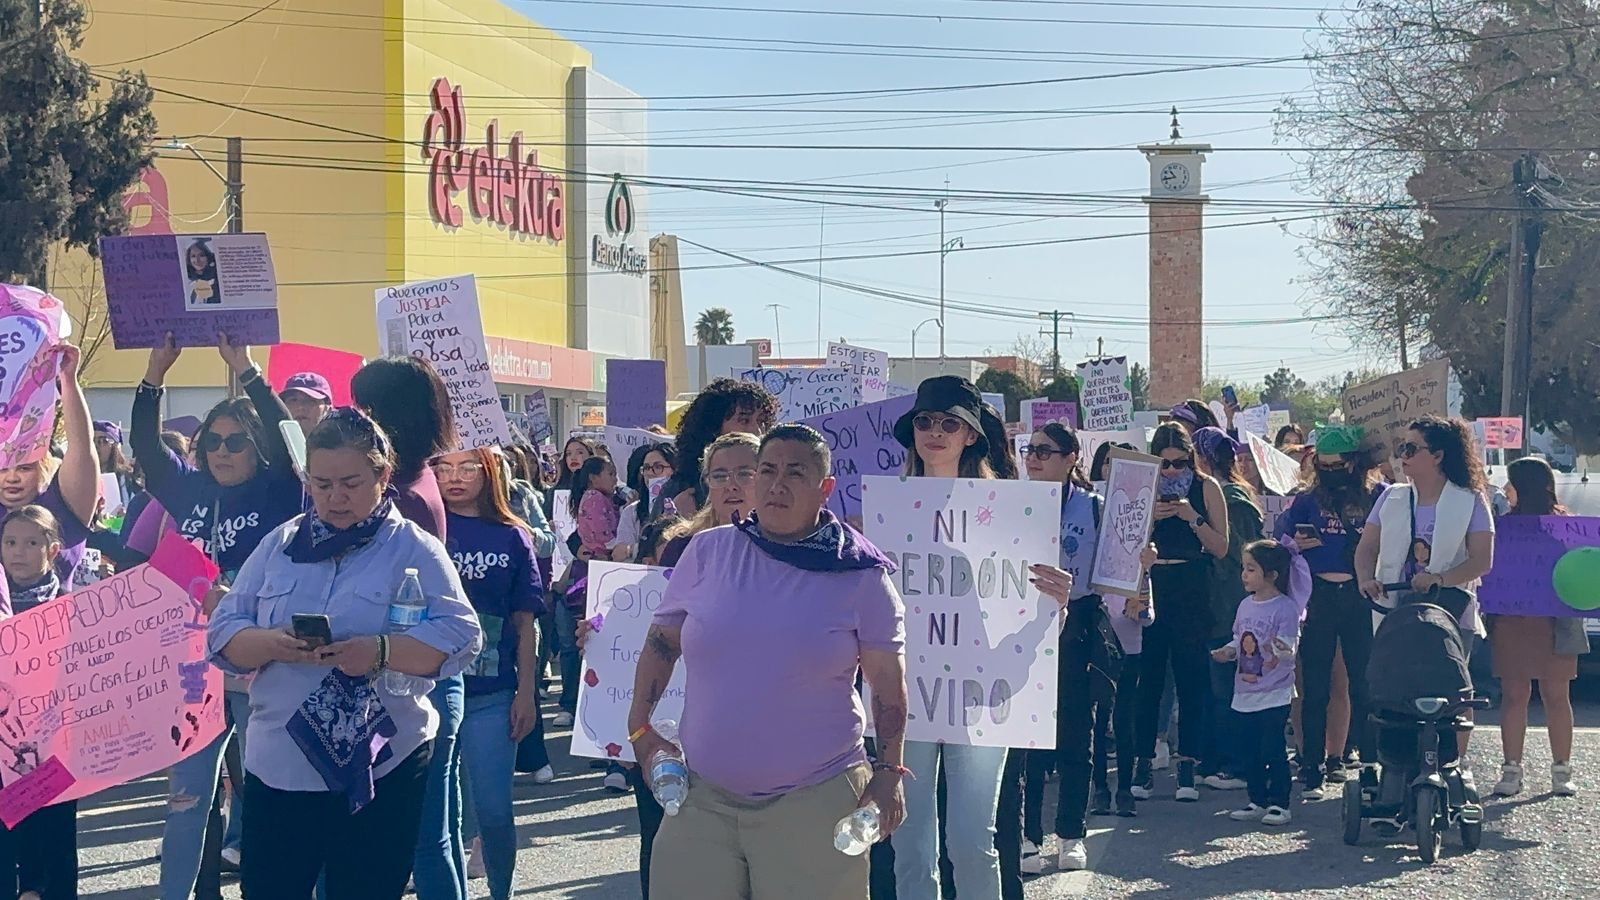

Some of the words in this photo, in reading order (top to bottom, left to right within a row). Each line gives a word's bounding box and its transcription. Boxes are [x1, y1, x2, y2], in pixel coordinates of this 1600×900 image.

[468, 118, 565, 242] elektra
[592, 234, 620, 267] Banco
[387, 280, 460, 298] Queremos
[396, 295, 451, 314] JUSTICIA
[408, 312, 445, 328] Para
[830, 345, 857, 359] ESTO
[863, 351, 876, 362] ES
[437, 366, 458, 376] ara
[446, 378, 481, 390] ujeres
[1086, 375, 1121, 388] QUEREMOS
[1099, 385, 1120, 396] LEYES
[467, 397, 498, 410] somos
[1083, 398, 1096, 407] QUE
[1091, 403, 1124, 418] QUEREMOS
[471, 418, 491, 429] las
[1087, 416, 1108, 430] LEYES
[1108, 415, 1121, 425] QUE
[460, 430, 470, 438] ue
[478, 427, 494, 435] no
[1118, 498, 1146, 516] LIBRES
[934, 509, 967, 543] NI
[453, 551, 510, 568] AMOS
[928, 612, 960, 646] NI
[15, 656, 41, 676] NO
[47, 641, 89, 667] ESTAN
[107, 626, 133, 646] LOS
[134, 605, 185, 635] CUENTOS
[65, 660, 80, 675] DE
[17, 687, 66, 717] ESTAN
[66, 682, 87, 702] EN
[89, 672, 122, 694] CASA
[123, 661, 147, 684] EN
[151, 654, 171, 675] LA
[136, 683, 152, 702] EN
[153, 679, 169, 696] LA
[916, 676, 1012, 727] VIDO
